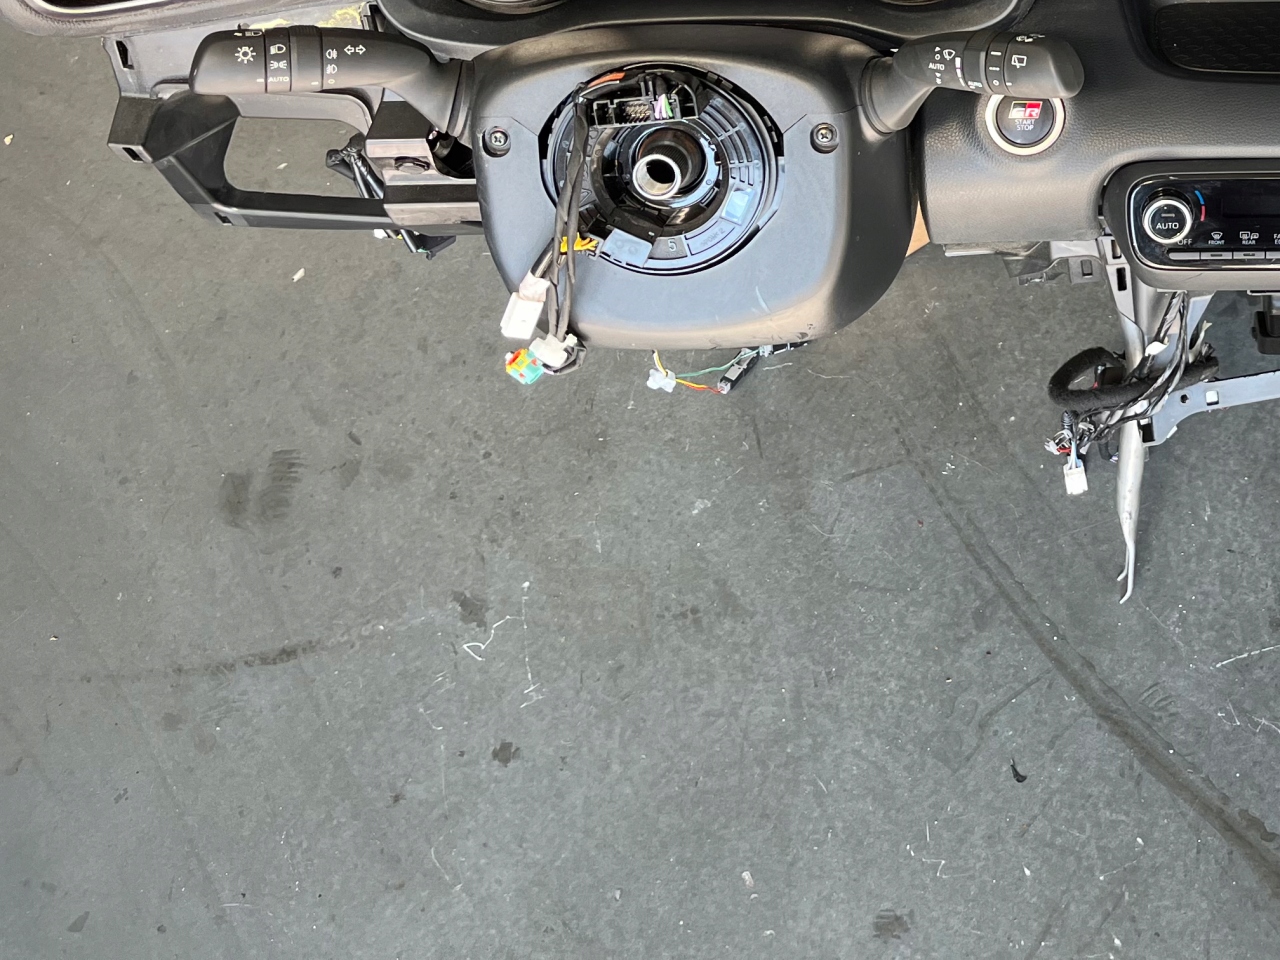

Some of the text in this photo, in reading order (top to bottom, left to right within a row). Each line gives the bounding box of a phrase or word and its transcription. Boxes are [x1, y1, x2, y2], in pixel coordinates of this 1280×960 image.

[928, 62, 945, 71] AUTO
[1156, 222, 1179, 230] AUTO
[1177, 238, 1193, 246] OFF
